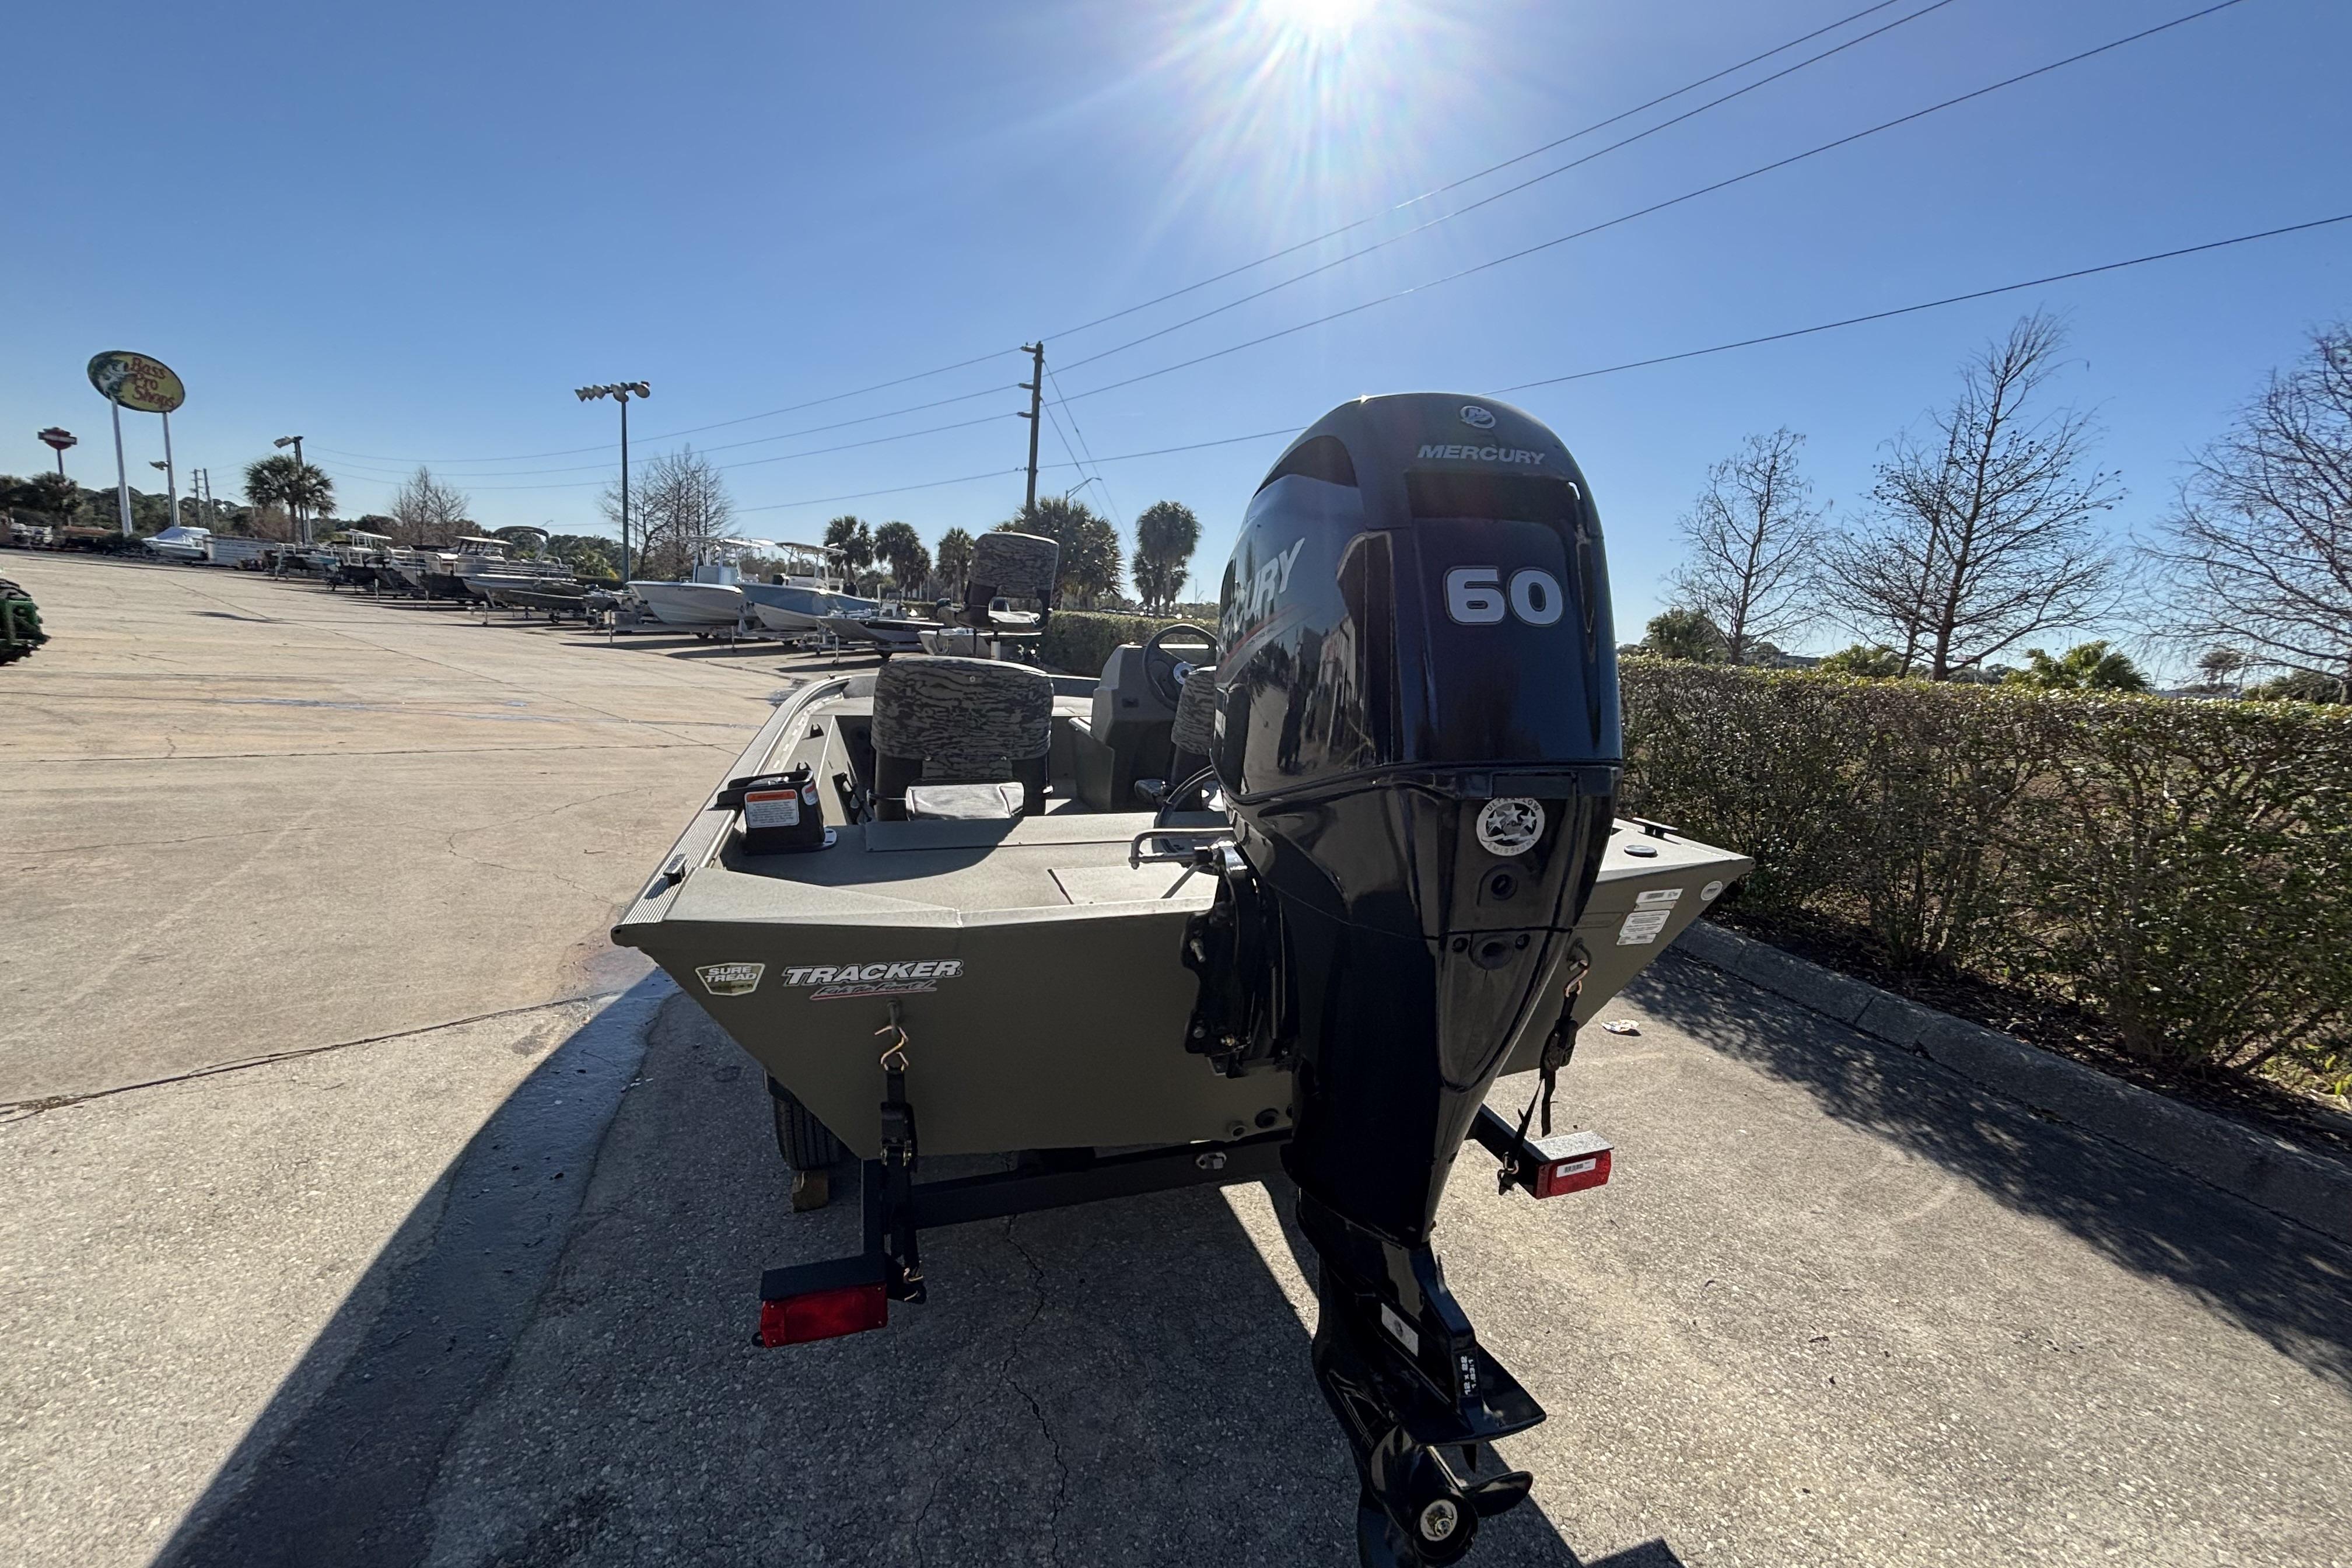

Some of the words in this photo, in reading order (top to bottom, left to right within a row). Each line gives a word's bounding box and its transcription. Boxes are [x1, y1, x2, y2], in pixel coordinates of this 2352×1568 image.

[130, 357, 166, 379] Bass
[135, 373, 159, 390] Pro
[132, 386, 176, 408] Shops
[1418, 445, 1545, 464] MERCURY
[1220, 537, 1305, 650] RCURY
[1443, 565, 1565, 627] 60
[1488, 840, 1532, 853] EMISSION
[705, 973, 757, 983] TREAD
[708, 965, 752, 975] SURE
[785, 961, 961, 985] TRACKER
[1464, 1382, 1471, 1395] 12
